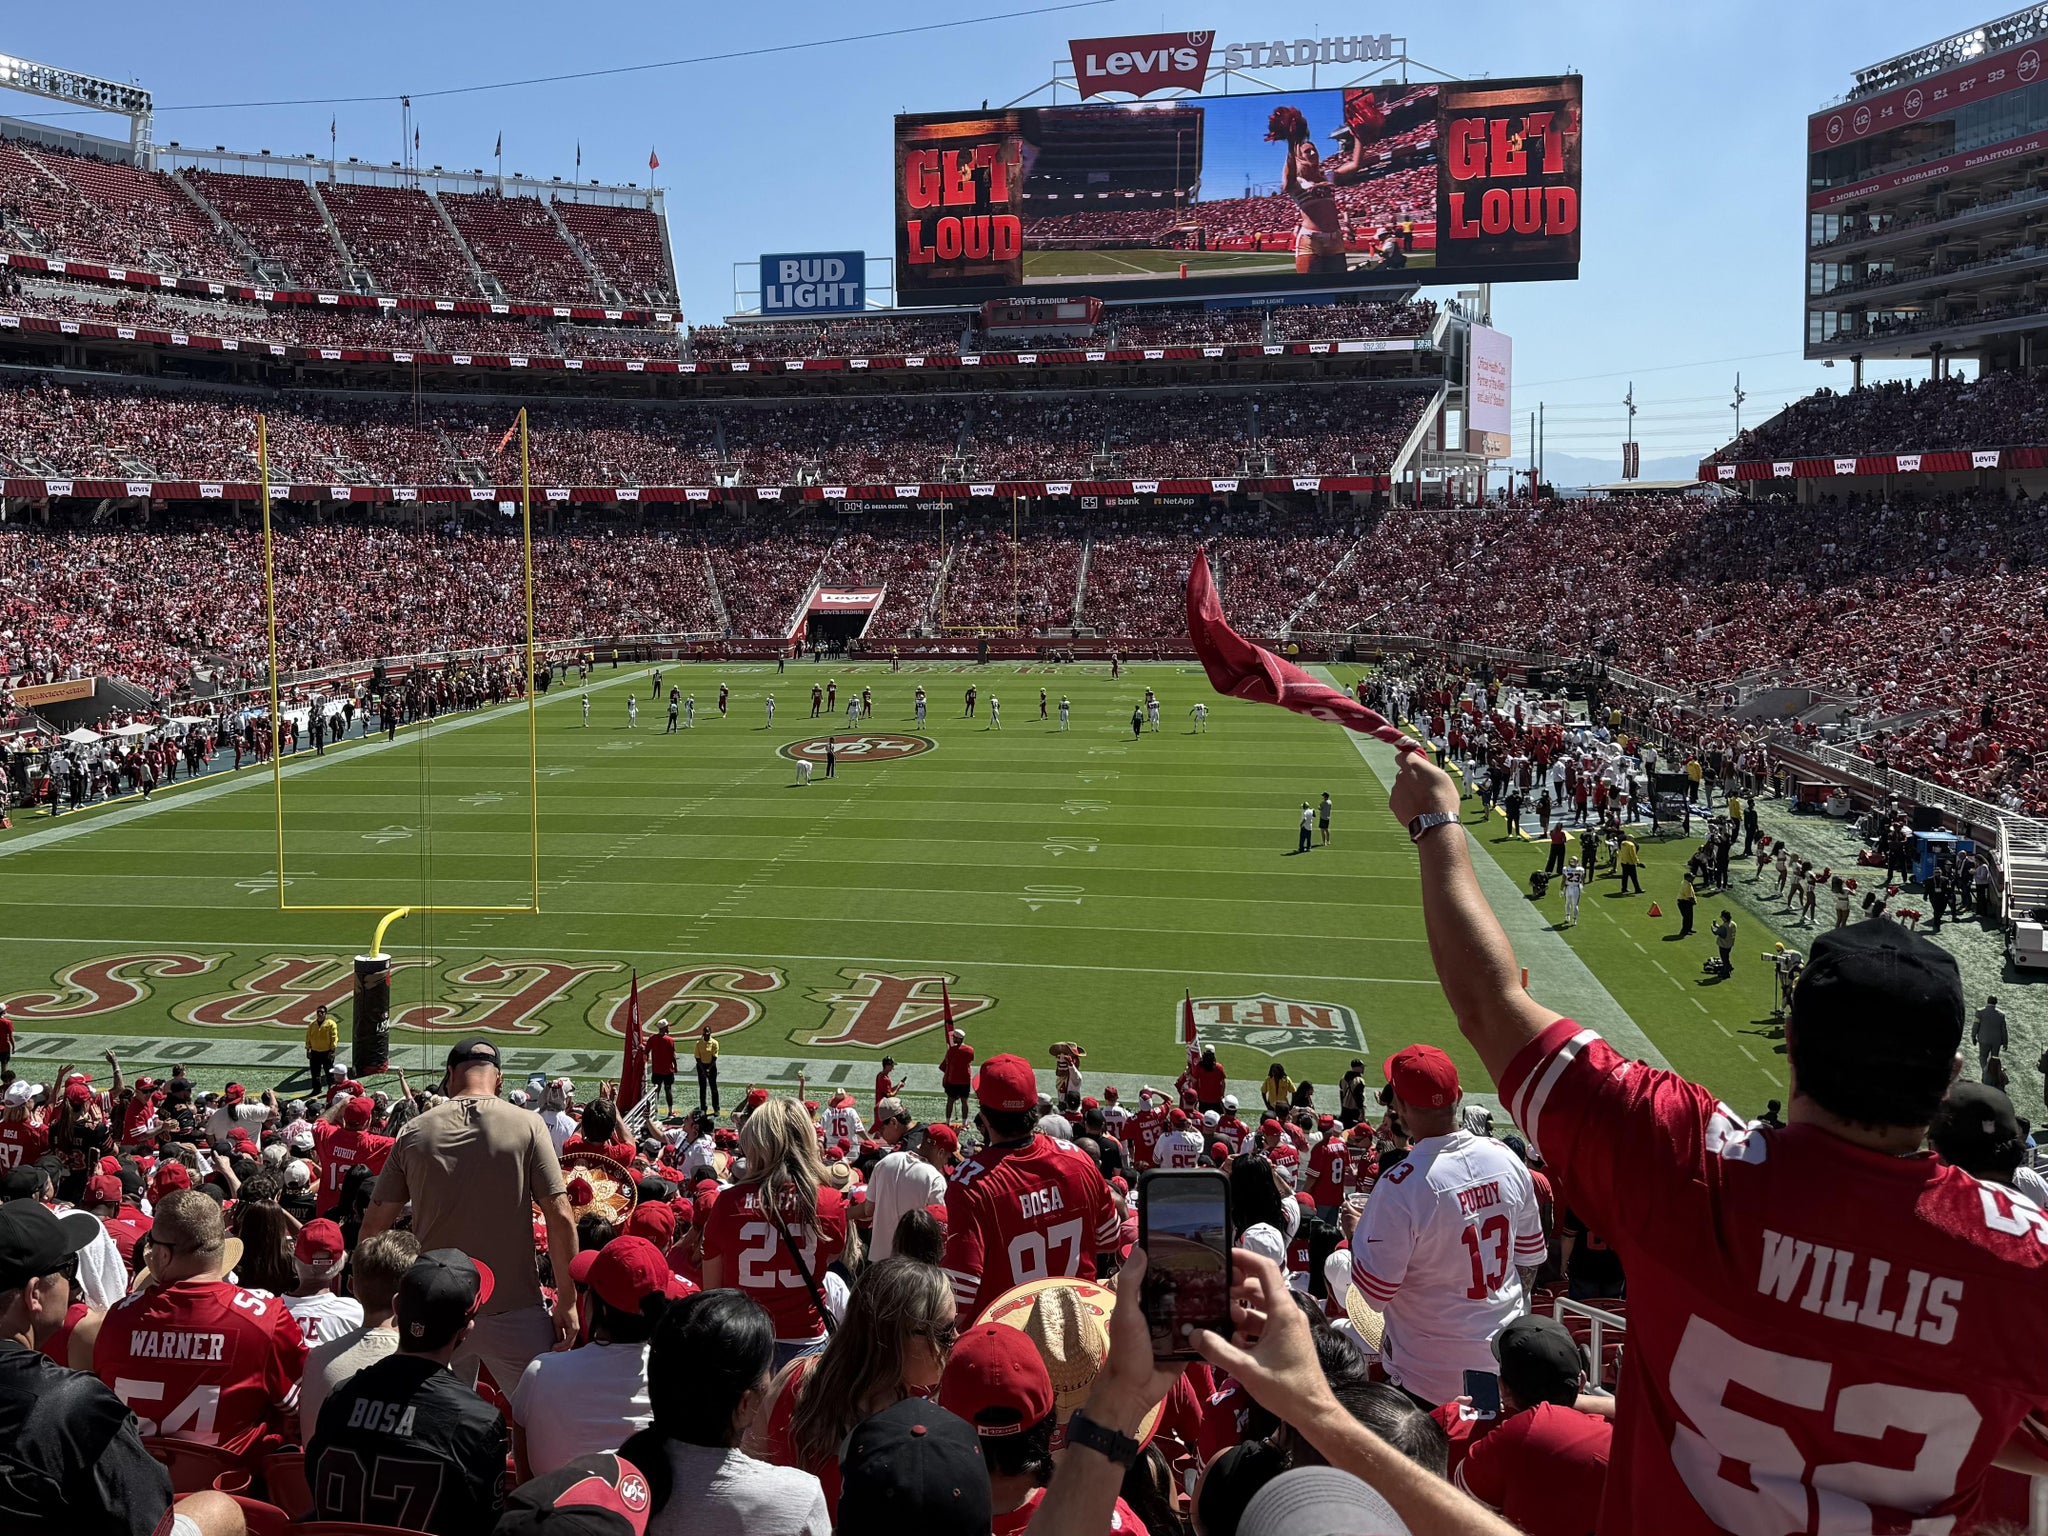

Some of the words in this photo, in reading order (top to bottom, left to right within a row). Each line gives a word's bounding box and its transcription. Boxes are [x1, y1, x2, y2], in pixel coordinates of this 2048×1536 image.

[1224, 33, 1393, 70] STADIUM
[1449, 109, 1578, 180] GET
[906, 139, 1023, 208] GET
[1900, 166, 1949, 184] MORABITO
[1836, 184, 1880, 202] MORABITO
[1449, 186, 1577, 238] LOUD
[907, 214, 1022, 264] LOUD
[780, 258, 846, 284] BUD
[766, 282, 859, 308] LIGHT
[916, 501, 953, 510] verizon
[1084, 499, 1096, 507] 25
[1118, 497, 1140, 505] bank
[1567, 873, 1580, 882] 23
[1018, 884, 1085, 904] 10
[1198, 1001, 1339, 1030] NFL
[3, 1129, 18, 1139] BOSA
[831, 1117, 849, 1137] 16
[0, 1142, 23, 1169] 97
[333, 1146, 357, 1161] PURDY
[950, 1158, 985, 1186] 97
[1331, 1158, 1343, 1184] 8
[1019, 1186, 1064, 1220] BOSA
[1457, 1181, 1501, 1215] PURDY
[739, 1222, 817, 1288] 23
[1008, 1217, 1083, 1285] 97
[1461, 1214, 1510, 1300] 13
[1757, 1229, 1963, 1345] WILLIS
[130, 1330, 225, 1361] WARNER
[114, 1376, 221, 1446] 54
[347, 1398, 417, 1438] BOSA
[1669, 1313, 1982, 1536] 52
